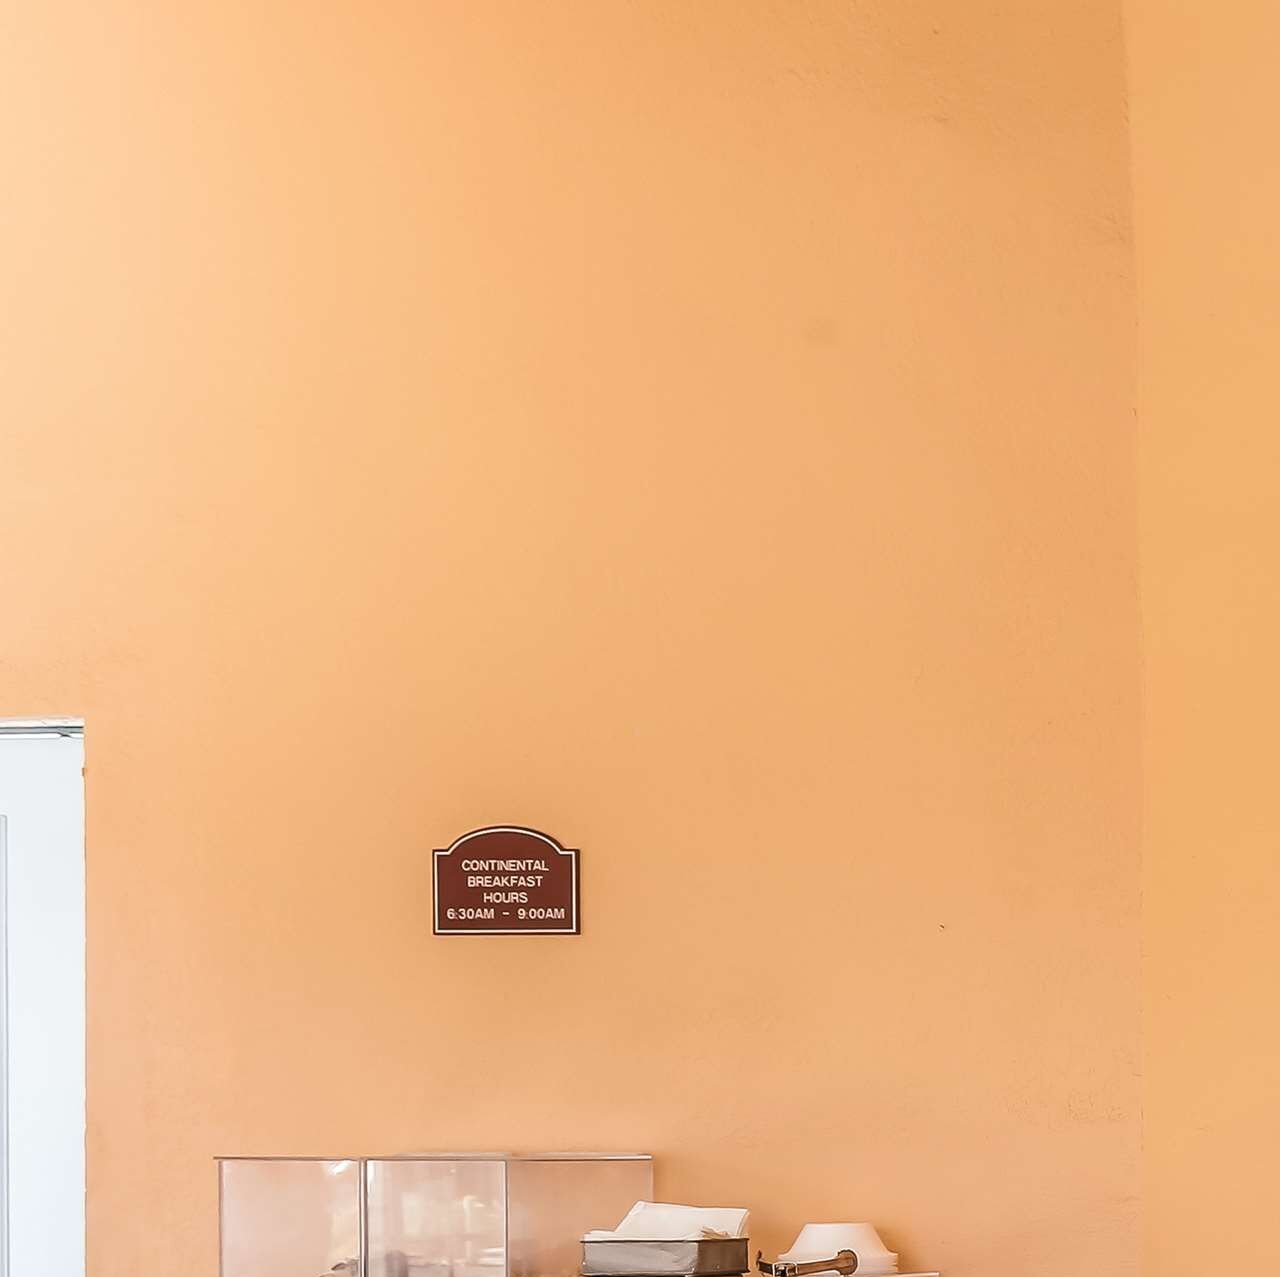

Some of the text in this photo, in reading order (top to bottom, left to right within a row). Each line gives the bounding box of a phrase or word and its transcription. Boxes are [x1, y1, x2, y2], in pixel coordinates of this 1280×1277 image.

[461, 859, 549, 871] CONTINENTAL
[467, 876, 544, 887] BREAKFAST
[483, 892, 529, 903] HOURS
[446, 908, 495, 919] 6:30AM
[517, 908, 566, 919] 9:00AM
